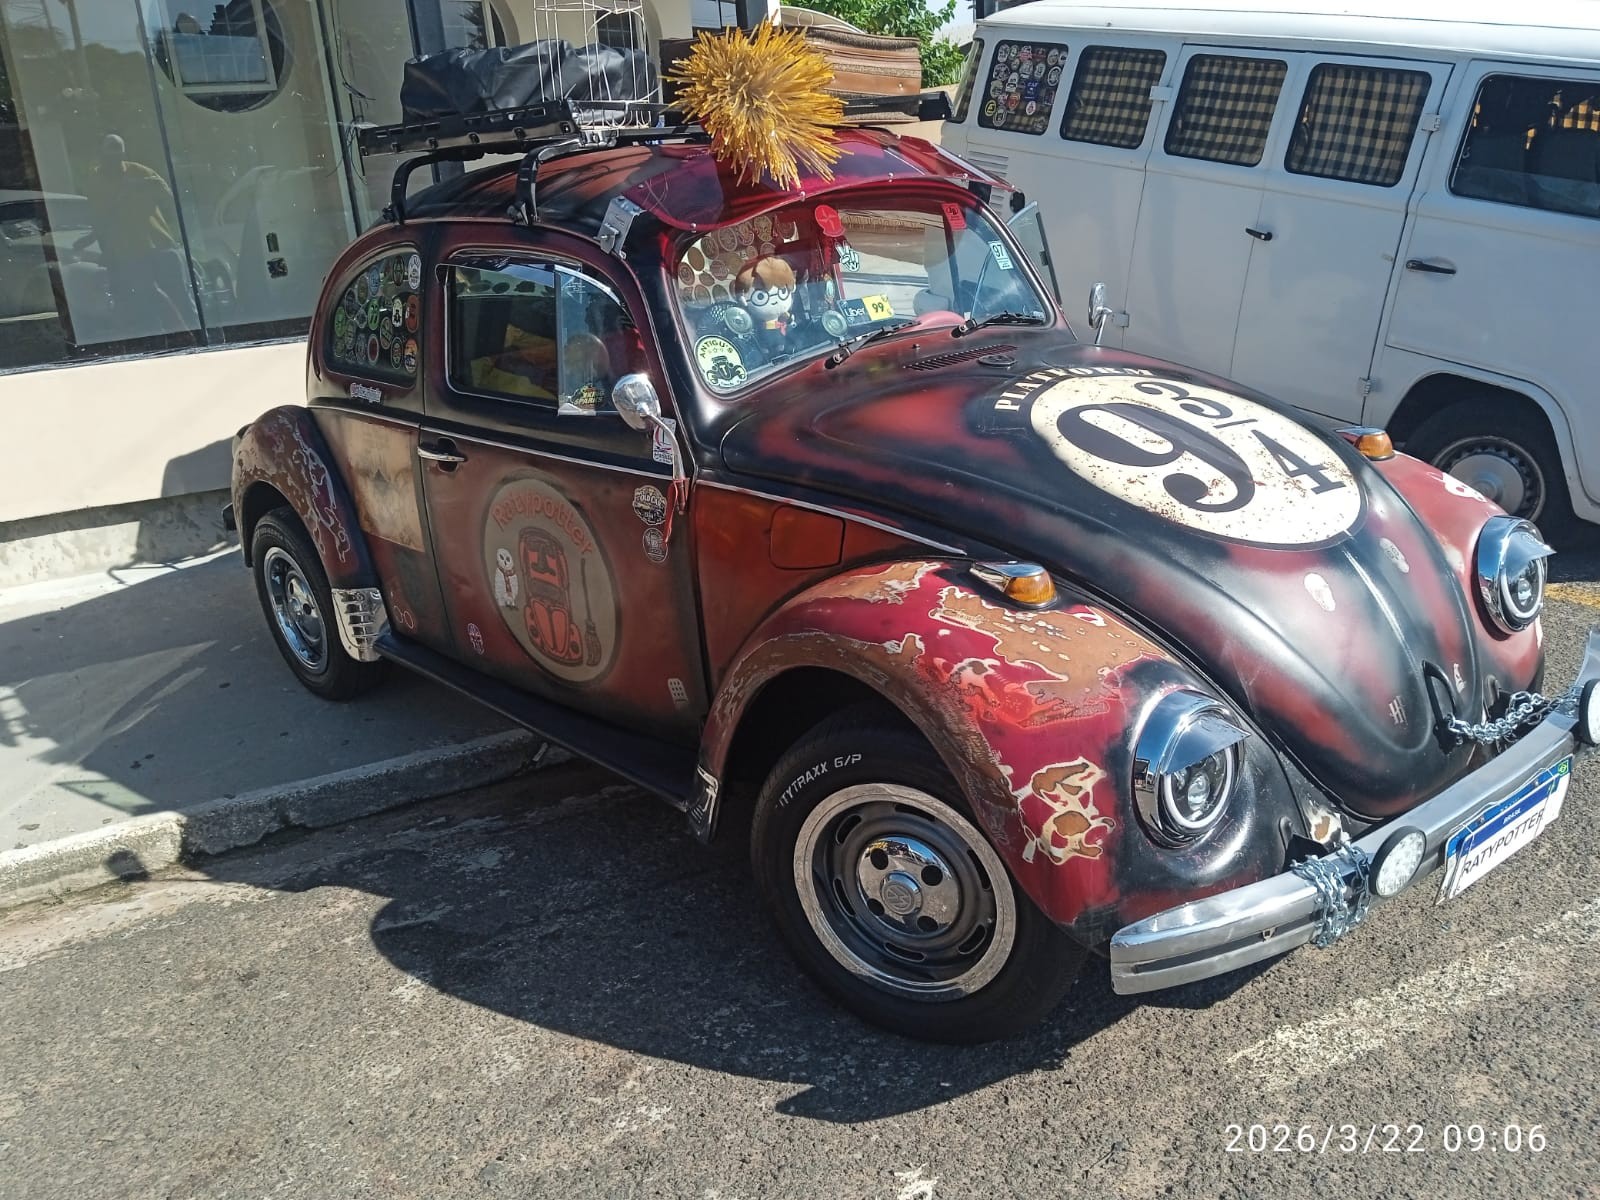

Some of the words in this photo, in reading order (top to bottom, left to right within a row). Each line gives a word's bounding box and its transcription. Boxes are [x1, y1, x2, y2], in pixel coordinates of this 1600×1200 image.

[992, 244, 1004, 257] 97
[872, 302, 884, 314] 99
[994, 367, 1154, 412] PLATFORM
[834, 753, 862, 768] G/P
[774, 761, 828, 808] ITYTRAXX
[1461, 808, 1545, 876] RATYPOTTER
